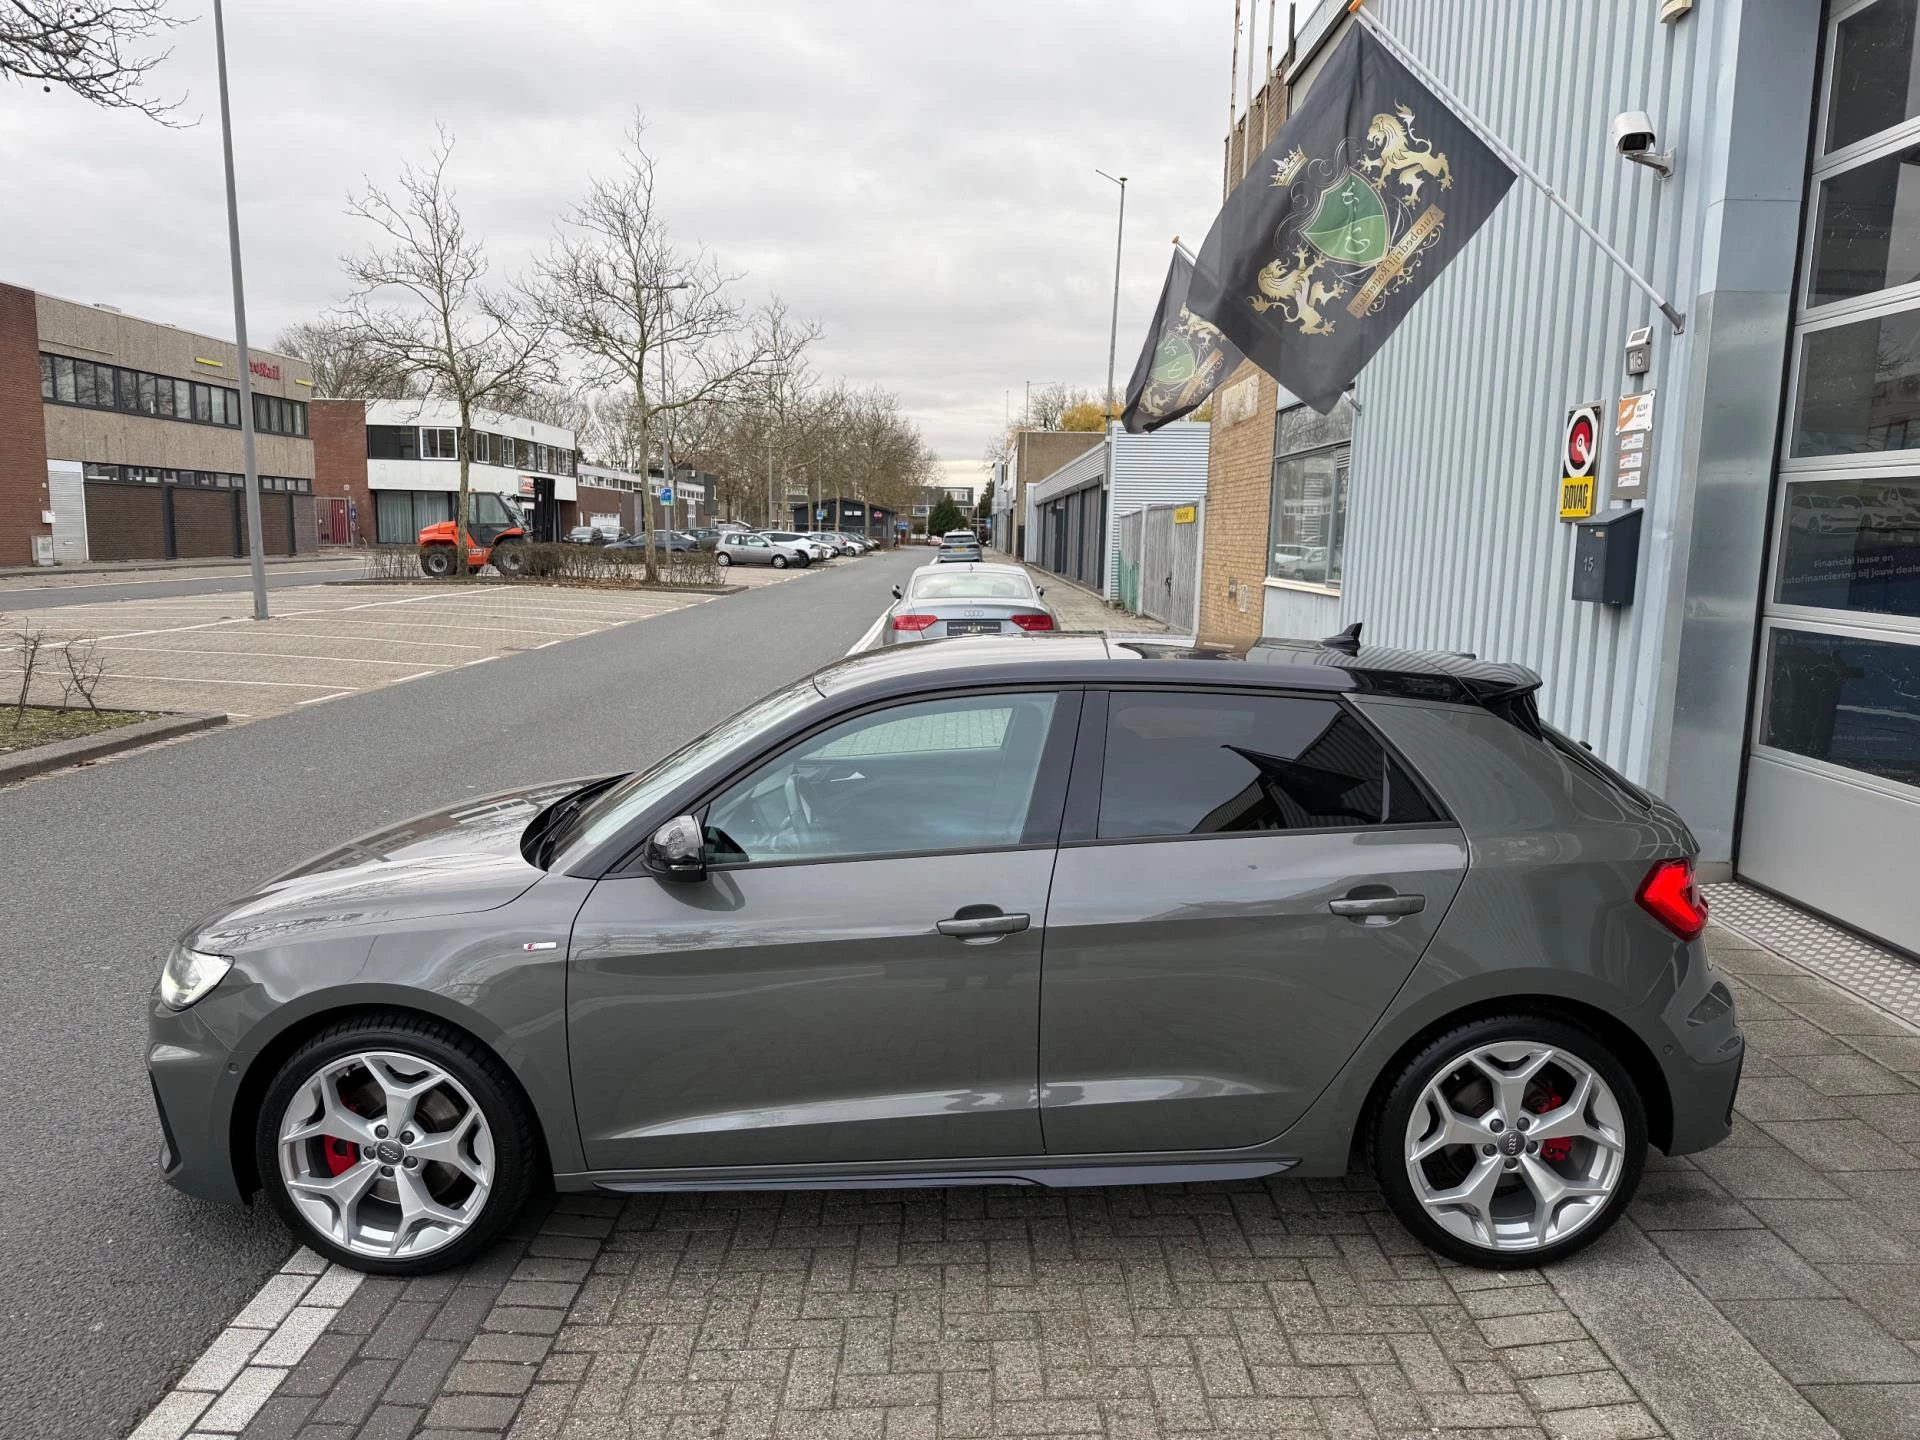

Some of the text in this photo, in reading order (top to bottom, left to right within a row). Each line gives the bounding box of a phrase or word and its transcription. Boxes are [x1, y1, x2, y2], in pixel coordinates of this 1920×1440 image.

[1630, 351, 1643, 367] 15
[248, 359, 281, 380] roRail
[1563, 484, 1588, 510] BOVAG
[1584, 556, 1594, 572] 15
[1814, 554, 1894, 568] Financial lease en
[1896, 563, 1920, 574] deale
